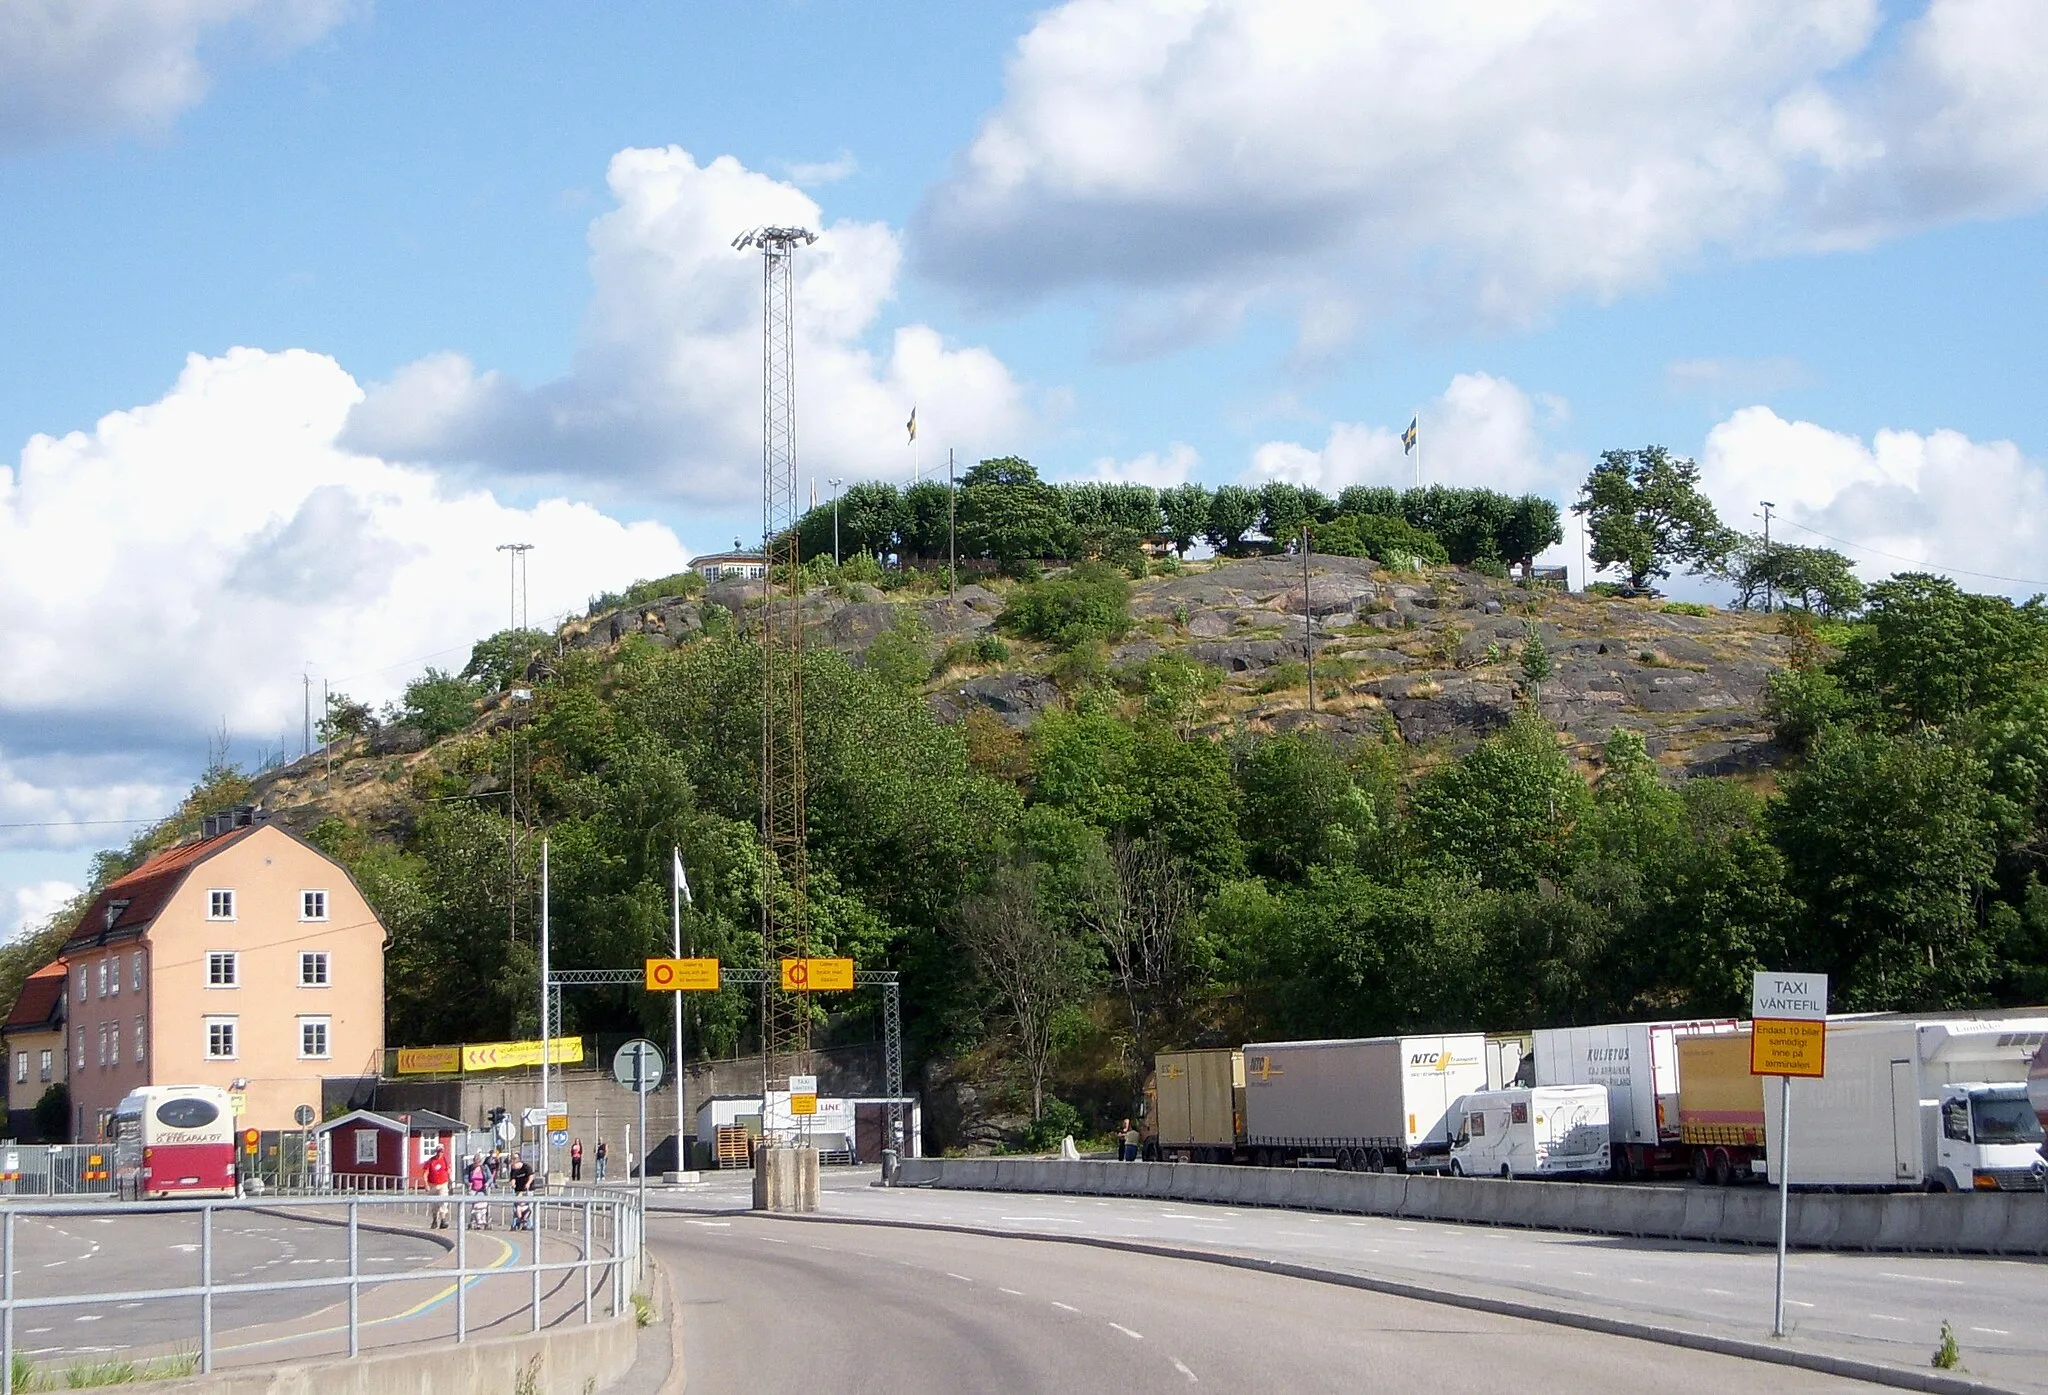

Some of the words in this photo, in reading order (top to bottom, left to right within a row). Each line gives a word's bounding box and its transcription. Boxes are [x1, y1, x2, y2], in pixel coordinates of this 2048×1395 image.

[1774, 980, 1808, 995] TAXI
[1760, 997, 1821, 1011] VÄNTEFIL
[1756, 1026, 1786, 1035] Endast
[1789, 1027, 1800, 1035] 10
[1802, 1027, 1820, 1036] bilar
[1769, 1038, 1808, 1048] samtidigt
[1411, 1053, 1439, 1064] NTC
[1587, 1047, 1630, 1061] KULJETUS
[1771, 1049, 1791, 1057] inne
[1792, 1049, 1803, 1058] på
[1765, 1060, 1810, 1069] terminalen
[820, 1103, 840, 1111] LINE
